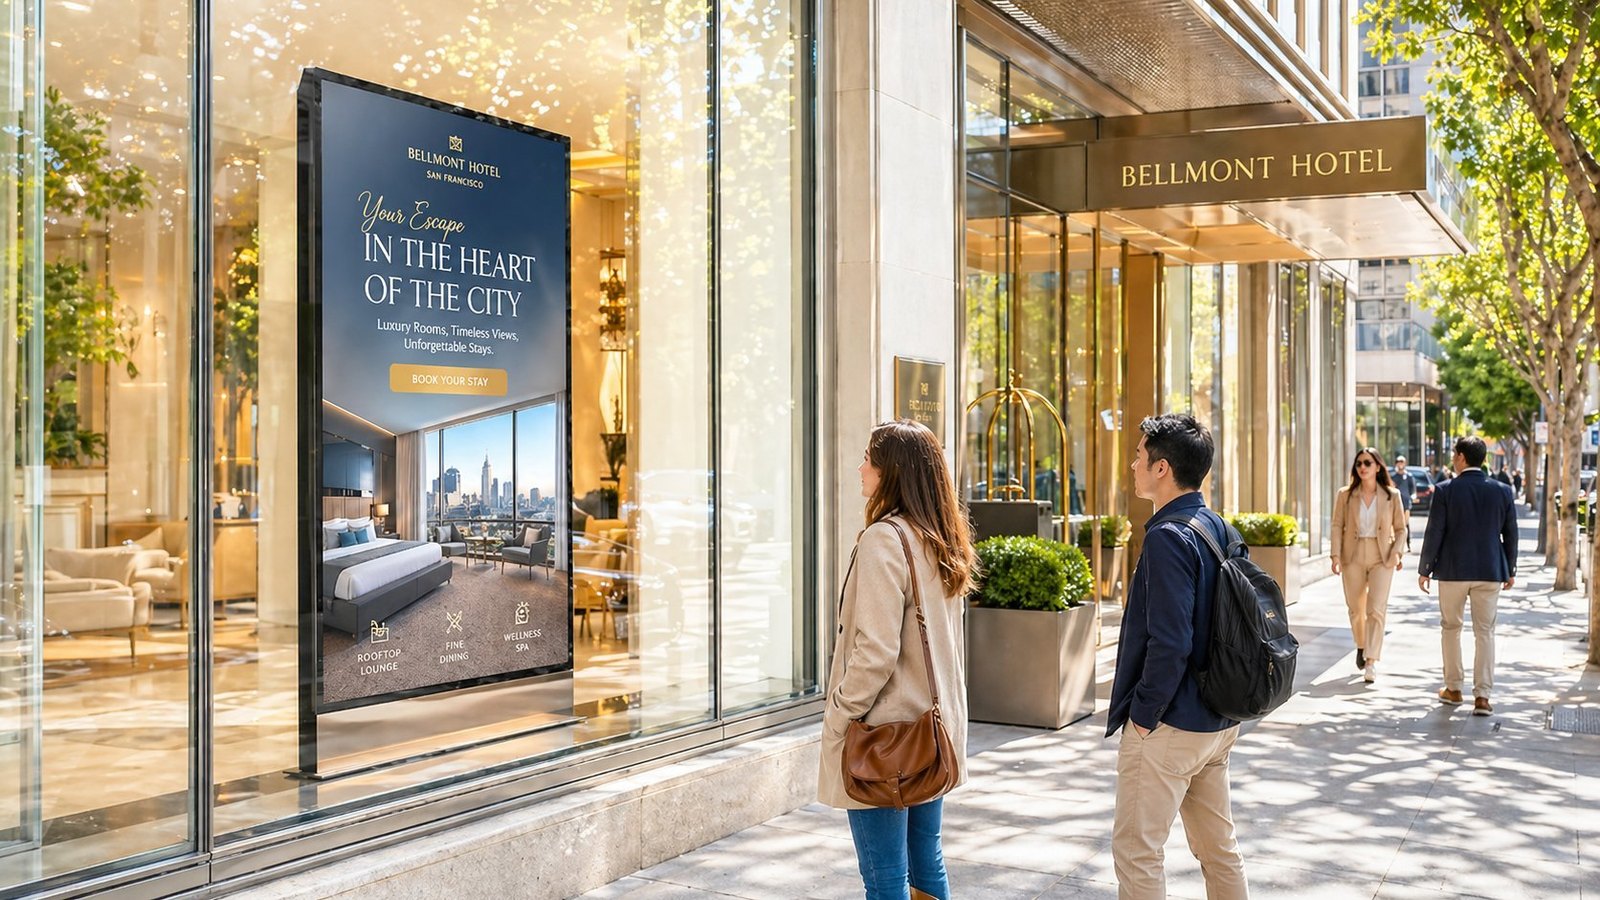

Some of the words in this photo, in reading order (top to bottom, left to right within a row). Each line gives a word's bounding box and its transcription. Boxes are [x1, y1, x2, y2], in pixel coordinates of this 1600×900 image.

[408, 147, 465, 170] BELLMONT
[469, 161, 501, 178] HOTEL
[1122, 156, 1275, 187] BELLMONT
[1291, 149, 1392, 177] HOTEL
[426, 170, 441, 180] SAN
[443, 173, 484, 189] FRANCISCO
[358, 190, 406, 233] Your
[409, 200, 465, 242] Escape
[364, 232, 392, 263] IN
[400, 237, 452, 273] THE
[460, 247, 536, 282] HEART
[364, 274, 402, 305] OF
[409, 279, 460, 311] THE
[467, 286, 522, 317] CITY
[377, 319, 411, 335] Luxury
[413, 322, 449, 337] Rooms,
[451, 325, 490, 339] Timeless
[491, 328, 519, 342] Views,
[404, 338, 466, 355] Unforgettable
[468, 342, 494, 357] Stays.
[412, 374, 438, 385] BOOK
[440, 374, 465, 386] YOUR
[467, 375, 489, 387] STAY
[445, 639, 464, 650] FINE
[503, 628, 542, 642] WELLNESS
[357, 648, 401, 662] ROOFTOP
[439, 651, 469, 664] DINING
[515, 643, 529, 653] SPA
[360, 662, 398, 676] LOUNGE
